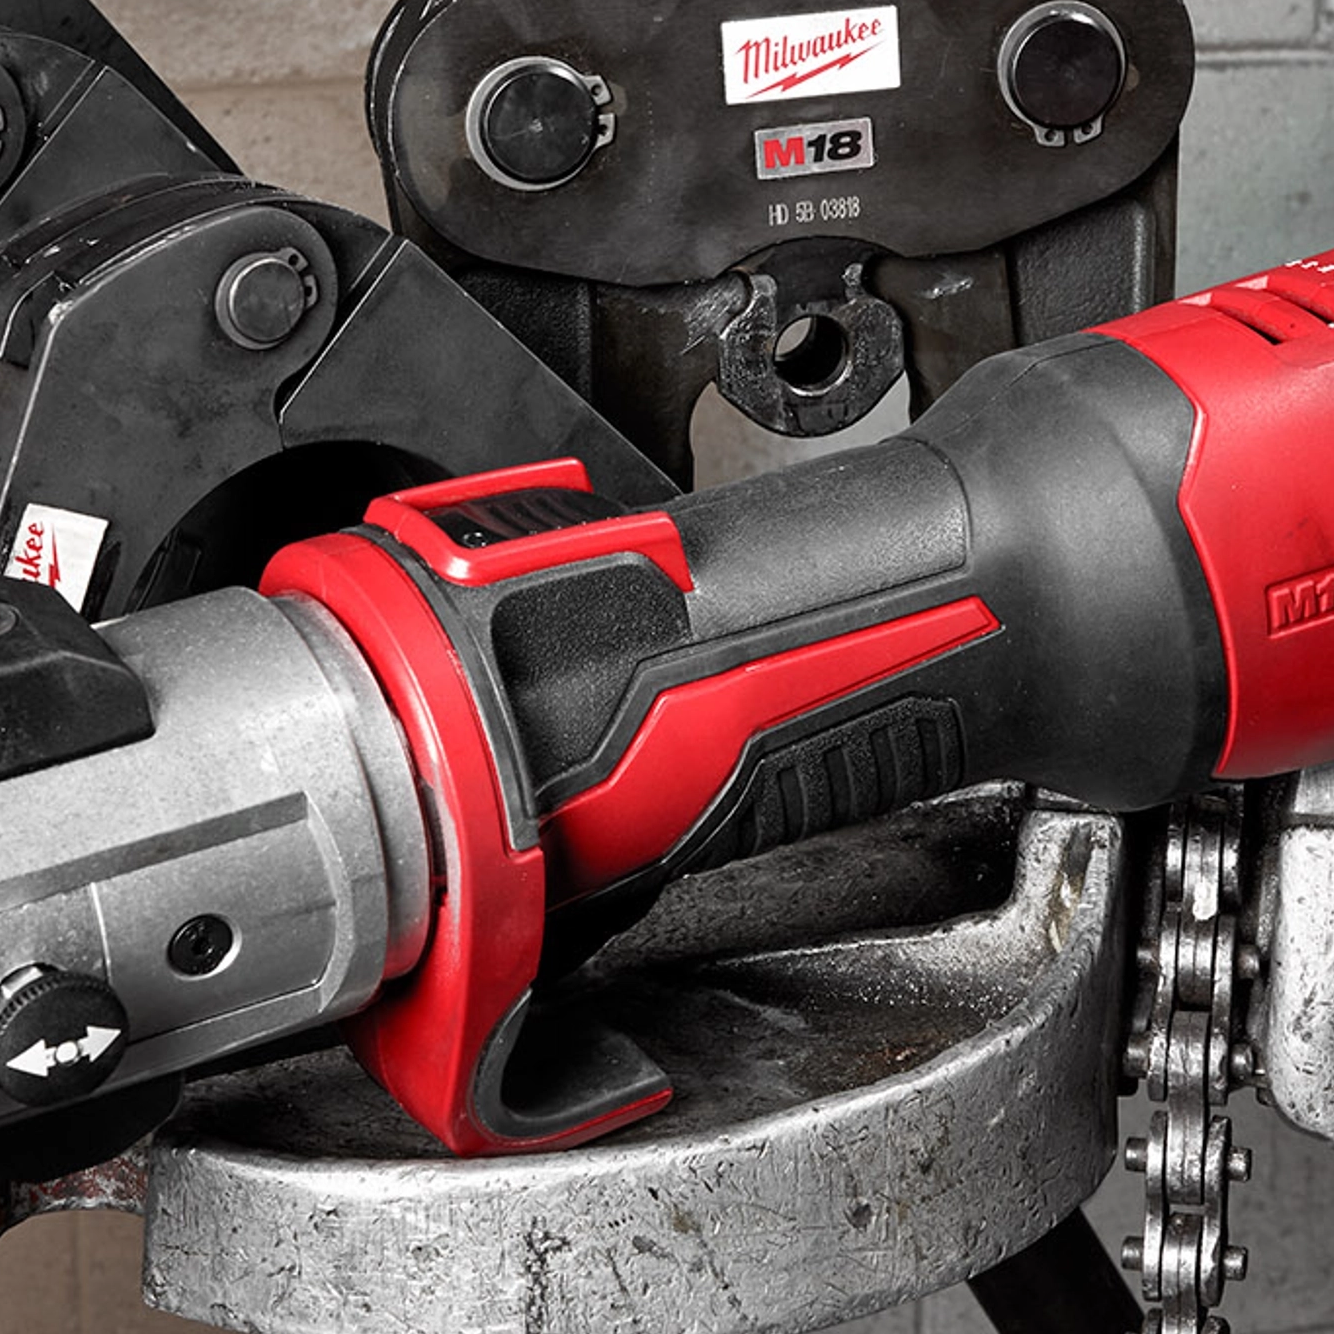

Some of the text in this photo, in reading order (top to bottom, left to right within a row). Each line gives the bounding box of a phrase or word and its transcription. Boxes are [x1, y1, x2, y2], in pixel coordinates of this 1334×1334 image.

[735, 17, 883, 84] Milwaukee
[763, 130, 862, 169] M18
[768, 203, 789, 226] HD
